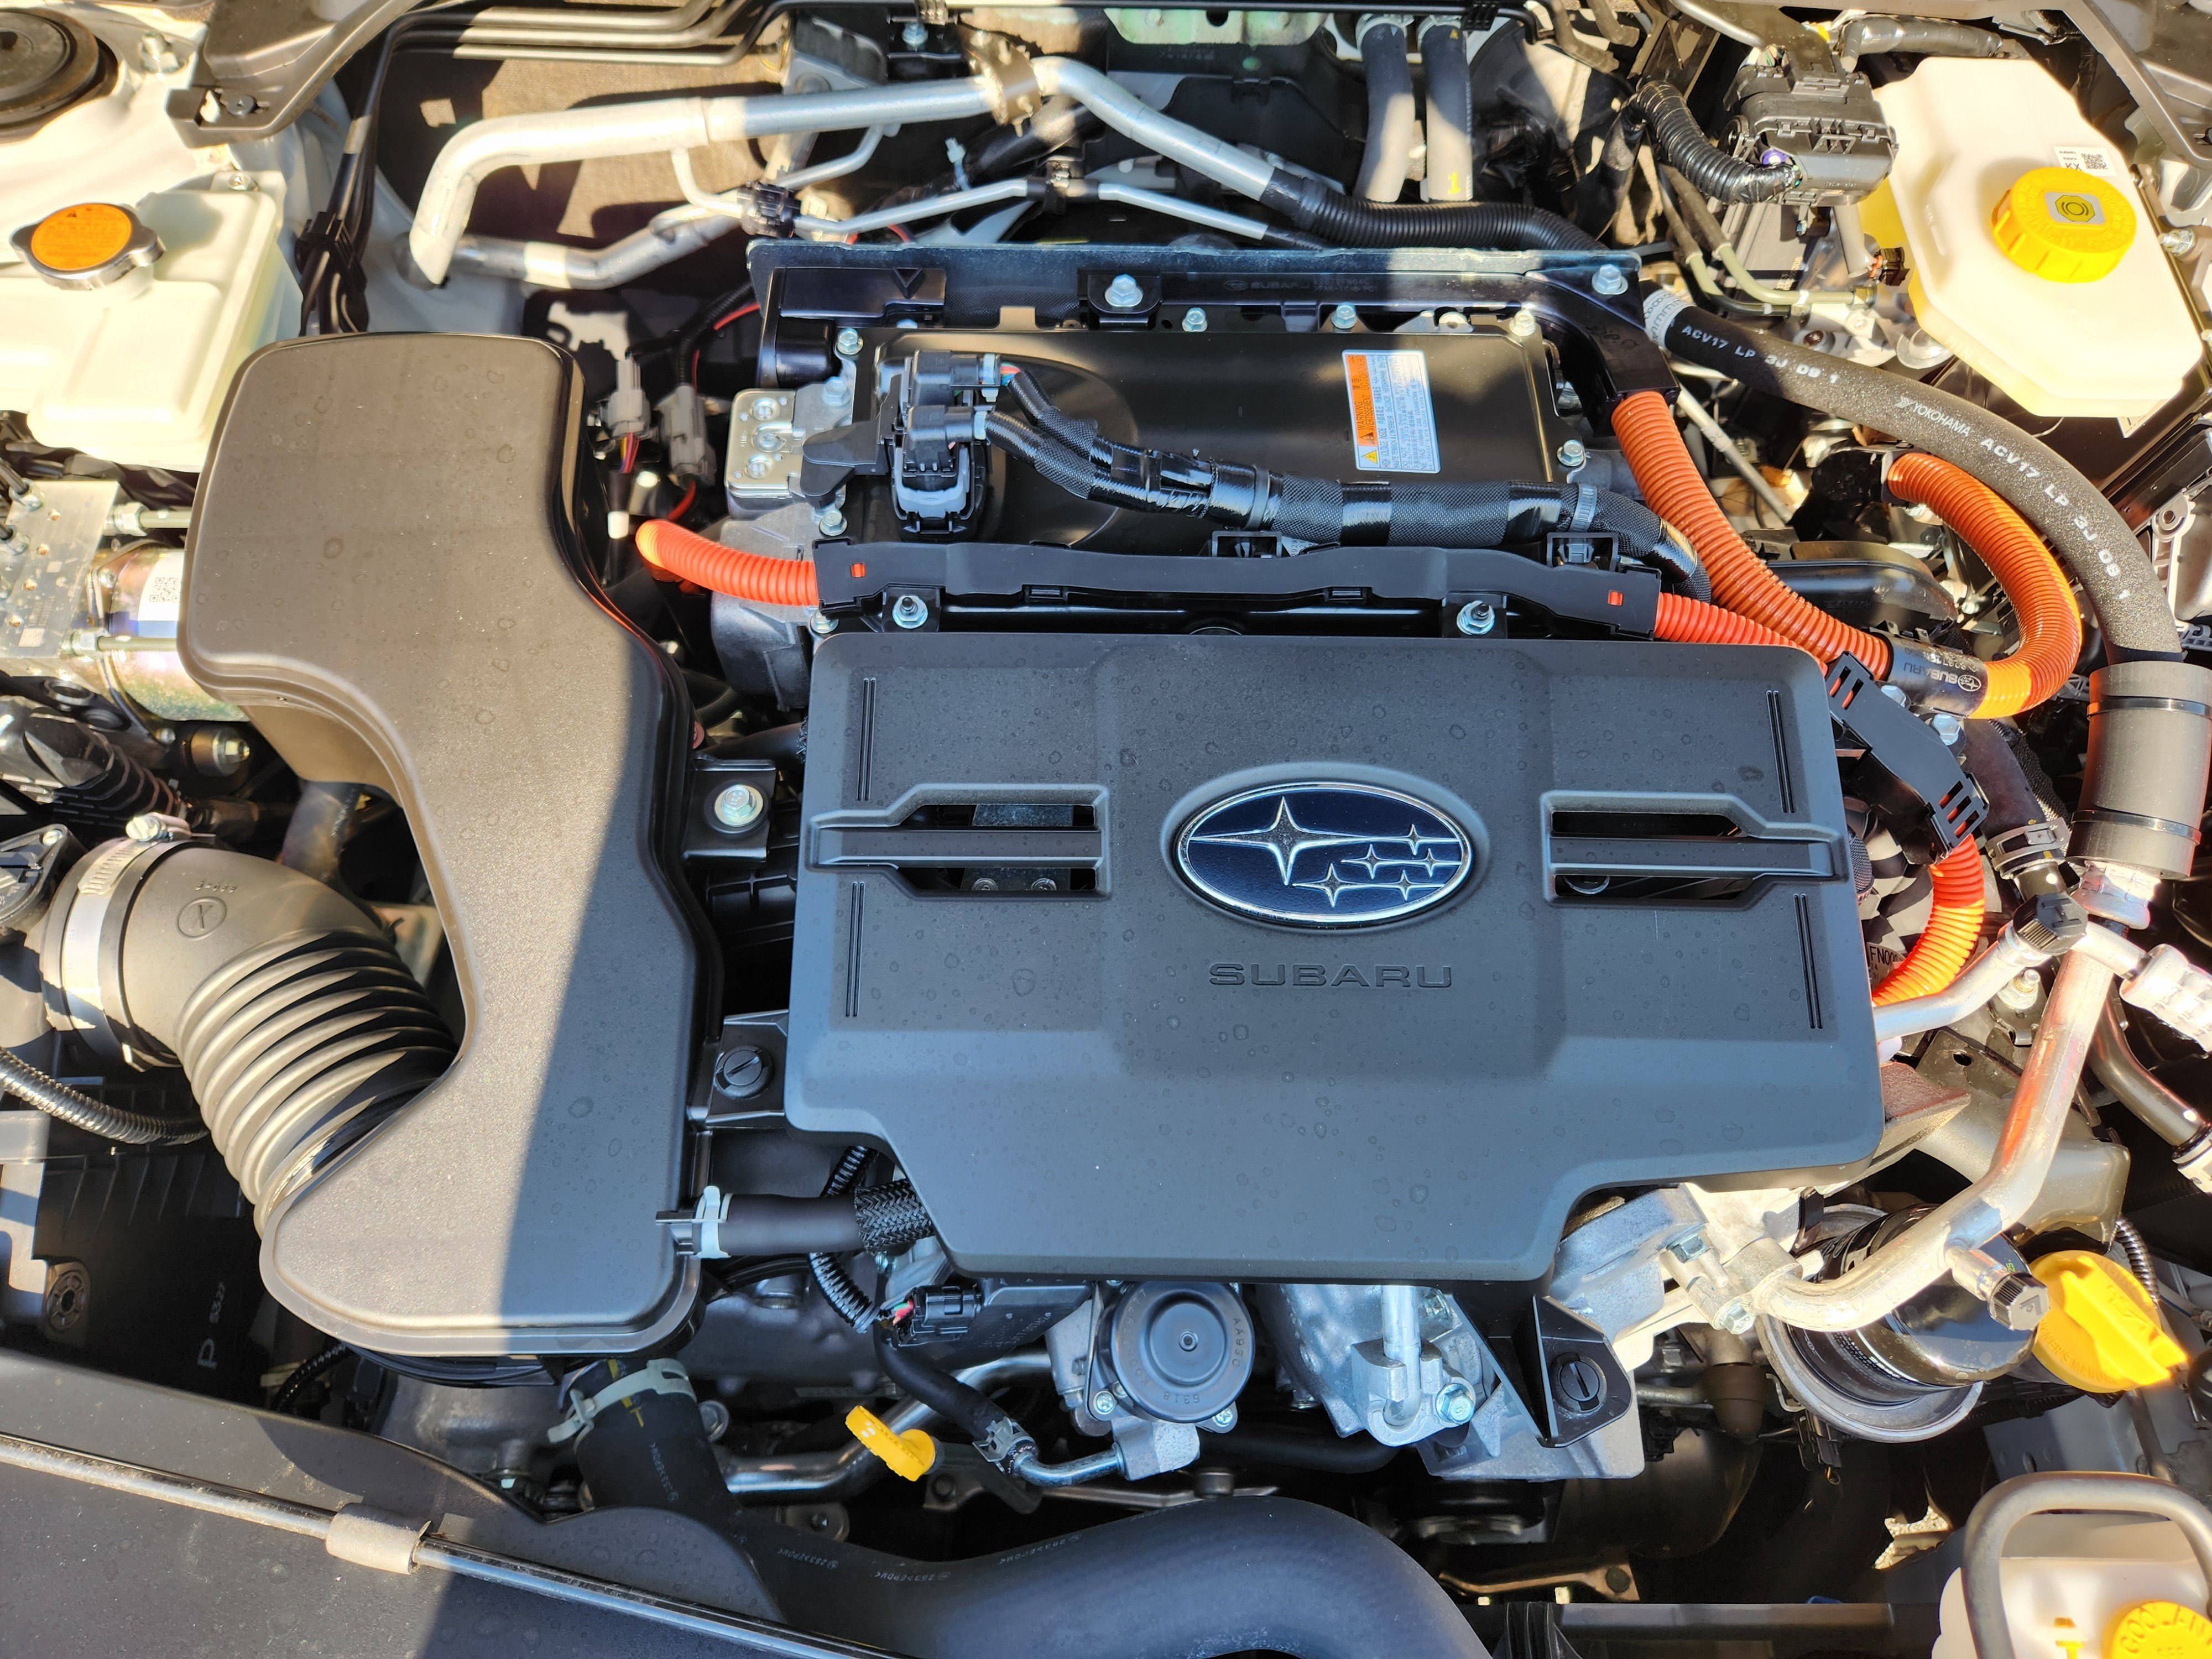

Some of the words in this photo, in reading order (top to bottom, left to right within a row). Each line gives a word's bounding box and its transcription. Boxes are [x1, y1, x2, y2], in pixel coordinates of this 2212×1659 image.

[1447, 171, 1462, 195] 1
[1681, 325, 1729, 349] ACV17
[1734, 345, 1757, 358] LP
[1354, 401, 1366, 430] WARNING
[1912, 402, 1971, 437] YOKOHAMA
[1980, 437, 2041, 479] ACV17
[2044, 484, 2070, 508] LP
[1903, 662, 1958, 685] SUBARU
[1209, 962, 1453, 988] SUBARU
[1231, 1317, 1246, 1368] AA930
[1162, 1392, 1201, 1405] 5318
